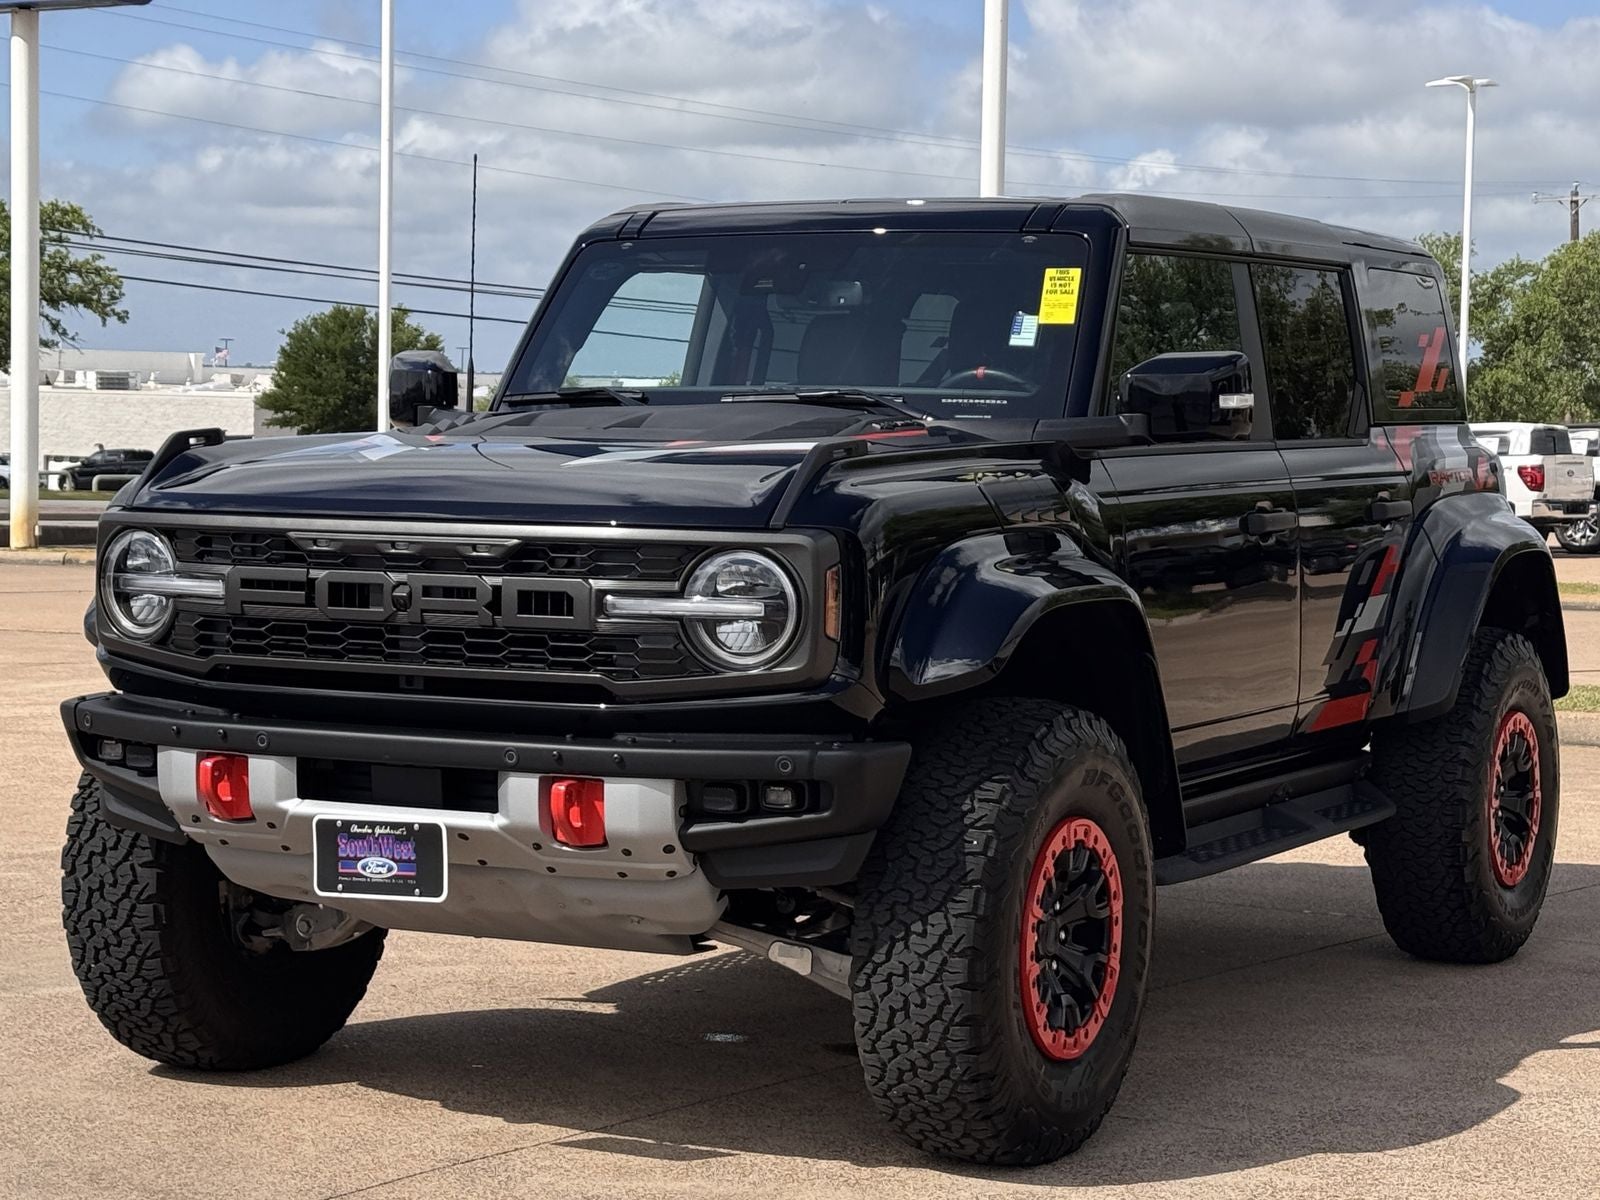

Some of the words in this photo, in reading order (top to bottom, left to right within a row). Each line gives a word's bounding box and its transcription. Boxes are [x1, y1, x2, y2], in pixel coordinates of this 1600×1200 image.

[227, 564, 592, 631] FORD
[337, 833, 417, 860] SouthWest
[365, 860, 388, 875] Ford
